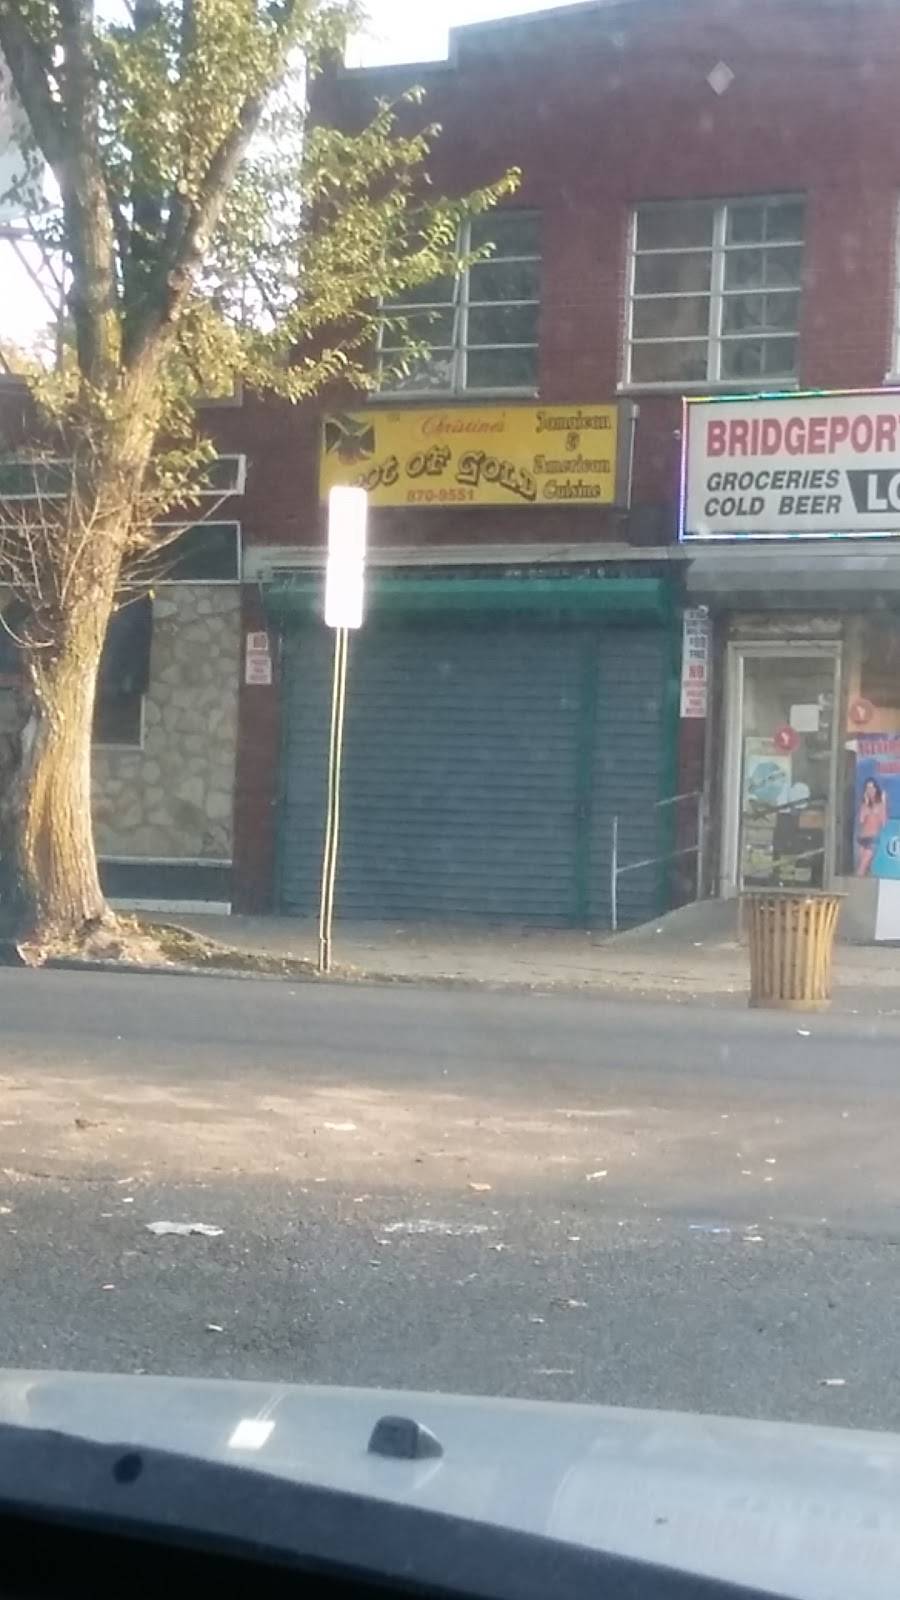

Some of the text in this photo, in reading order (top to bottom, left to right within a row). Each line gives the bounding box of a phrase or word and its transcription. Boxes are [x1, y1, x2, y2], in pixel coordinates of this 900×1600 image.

[536, 410, 612, 434] Jamaican
[706, 413, 900, 458] BRIDGEPOR
[533, 453, 611, 474] American
[543, 478, 602, 500] Cuisine
[706, 468, 841, 493] GROCERIES
[704, 494, 842, 518] COLD BEER
